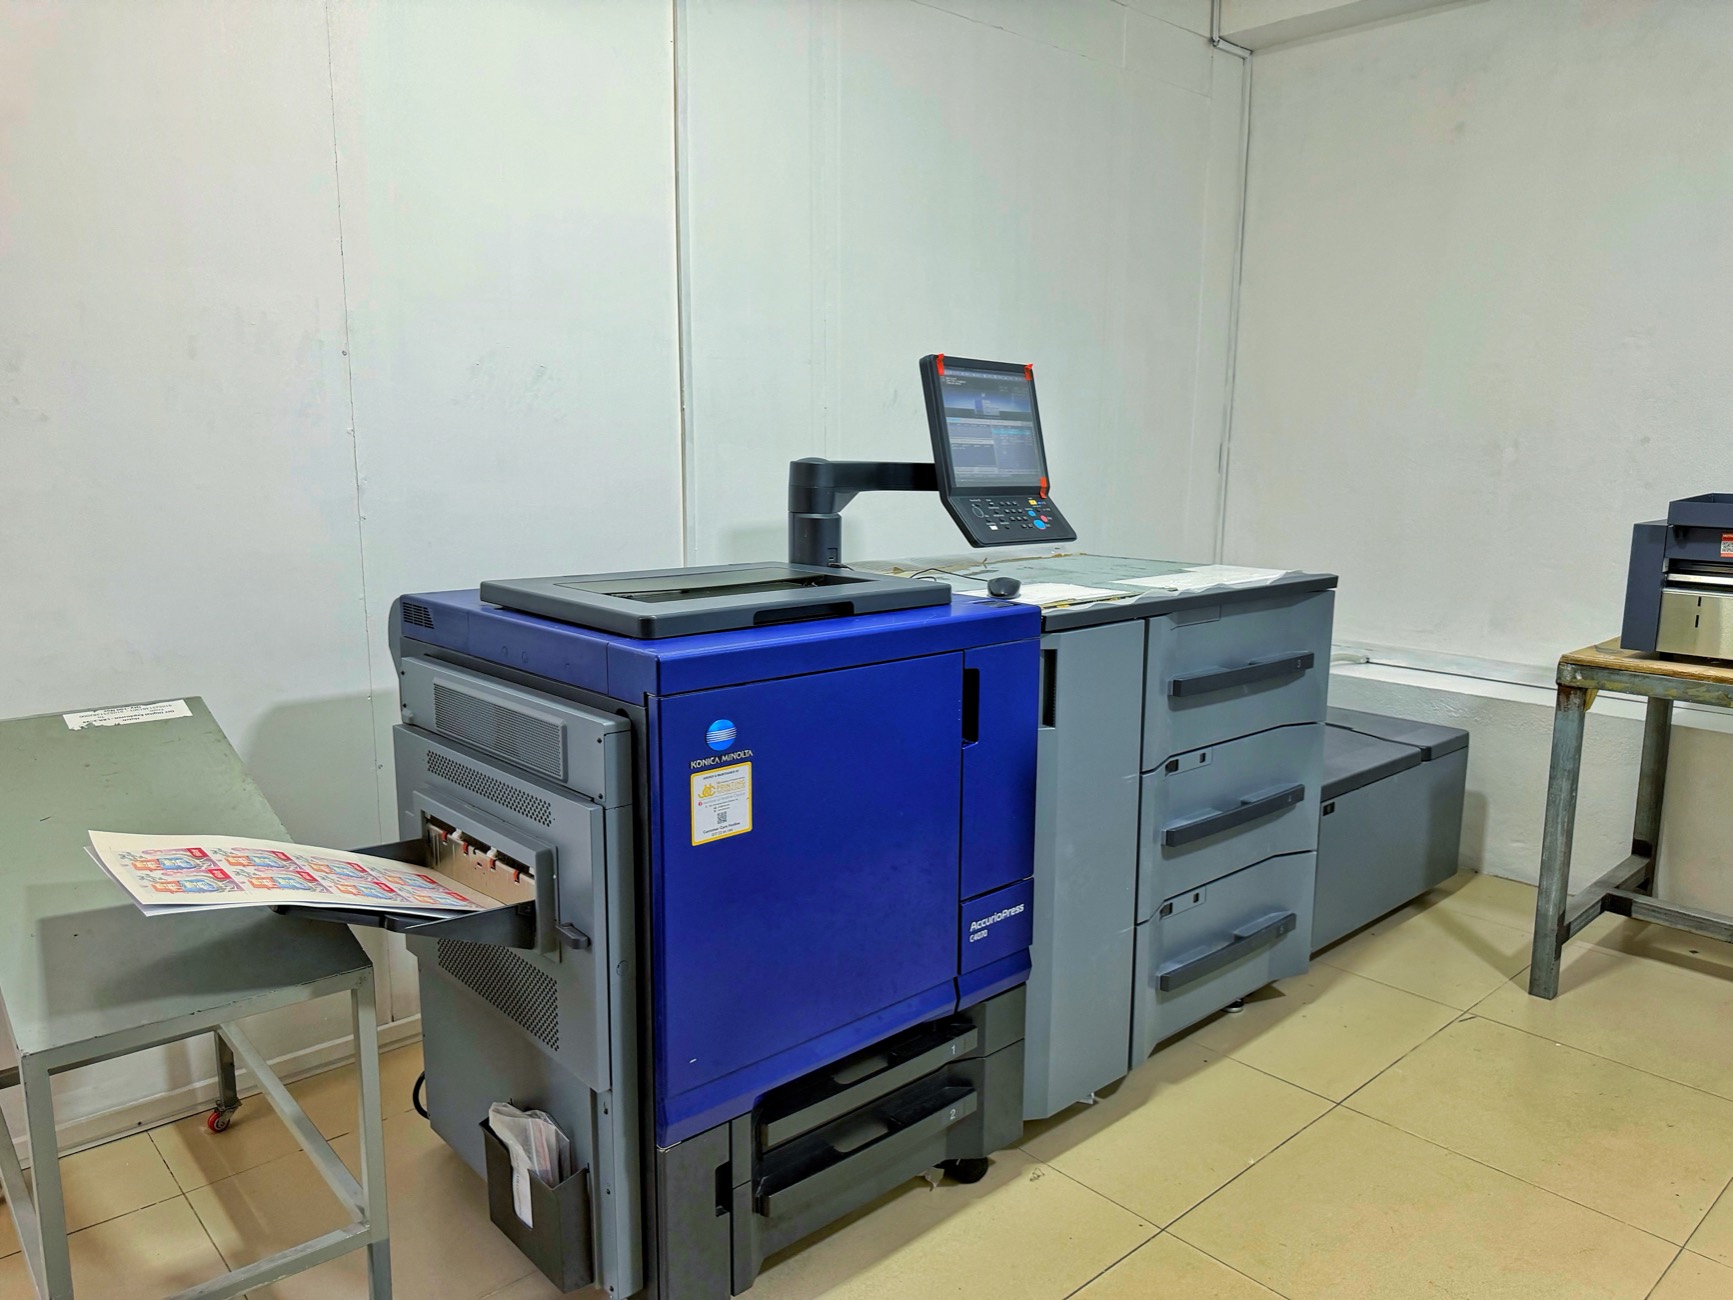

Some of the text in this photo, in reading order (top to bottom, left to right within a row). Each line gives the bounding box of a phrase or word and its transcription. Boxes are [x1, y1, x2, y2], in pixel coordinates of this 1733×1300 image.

[690, 750, 754, 769] KONICA MINOLTA
[969, 903, 1025, 932] AccurioPress
[952, 1044, 956, 1054] 1
[950, 1108, 956, 1120] 2
